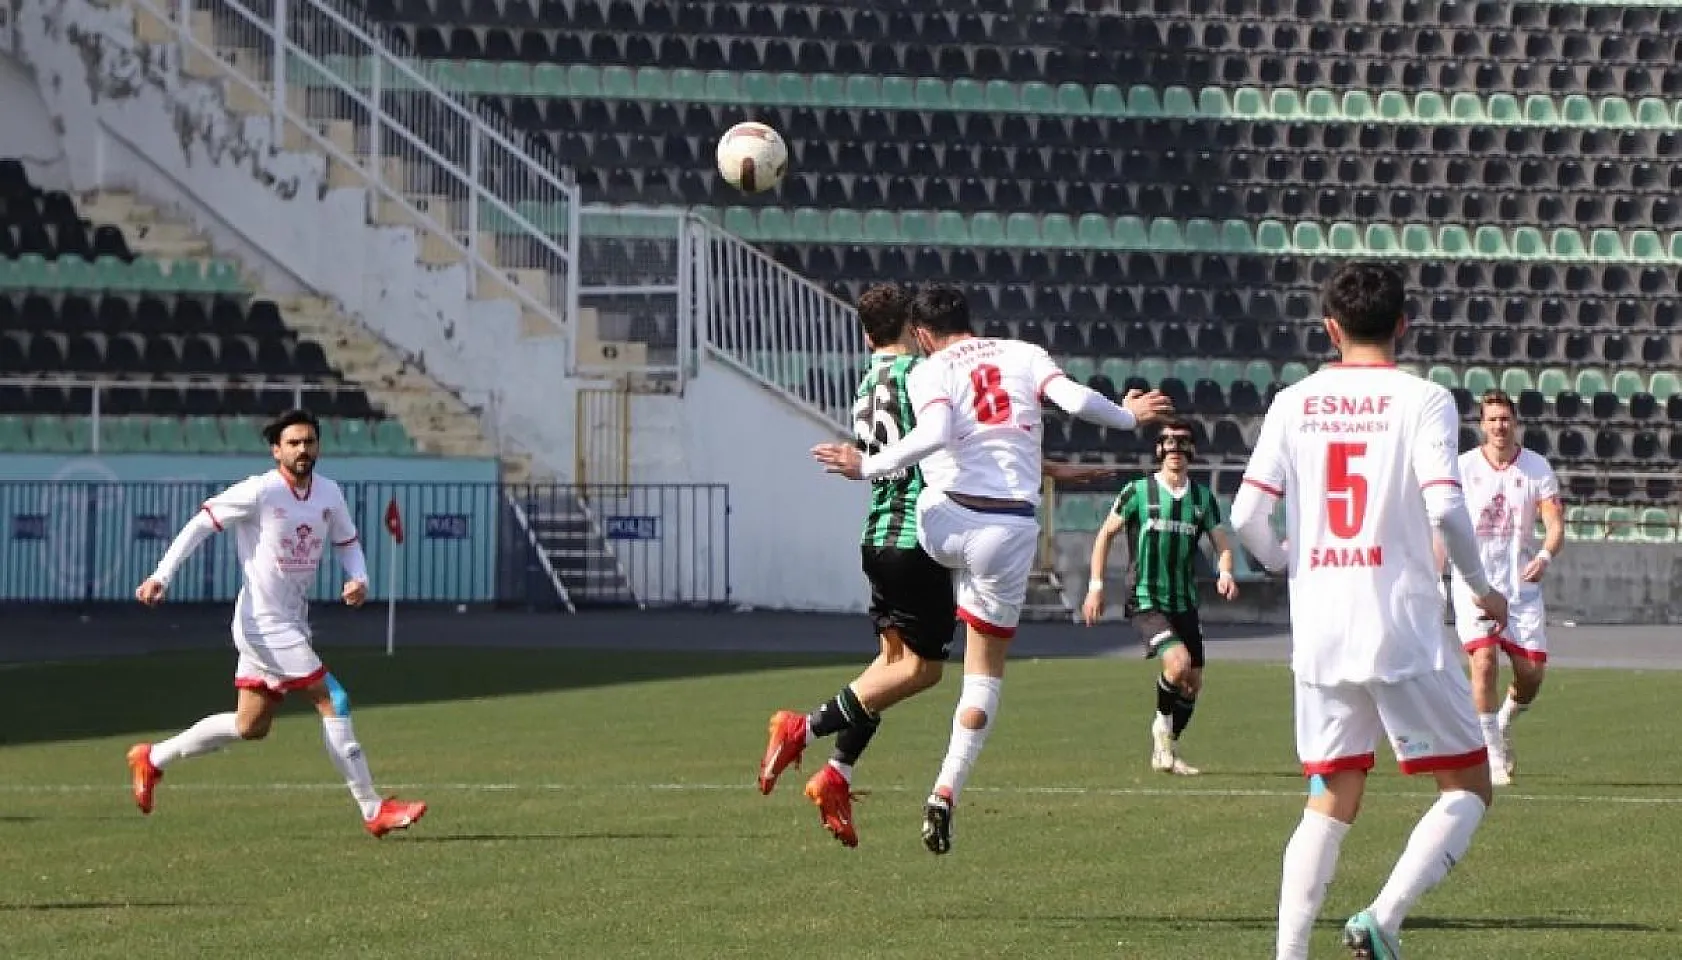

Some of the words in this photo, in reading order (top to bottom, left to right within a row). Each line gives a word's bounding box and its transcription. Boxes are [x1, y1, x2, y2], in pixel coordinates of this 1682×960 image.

[970, 363, 1012, 424] 8
[1303, 396, 1393, 415] ESNAF
[1326, 441, 1367, 539] 5
